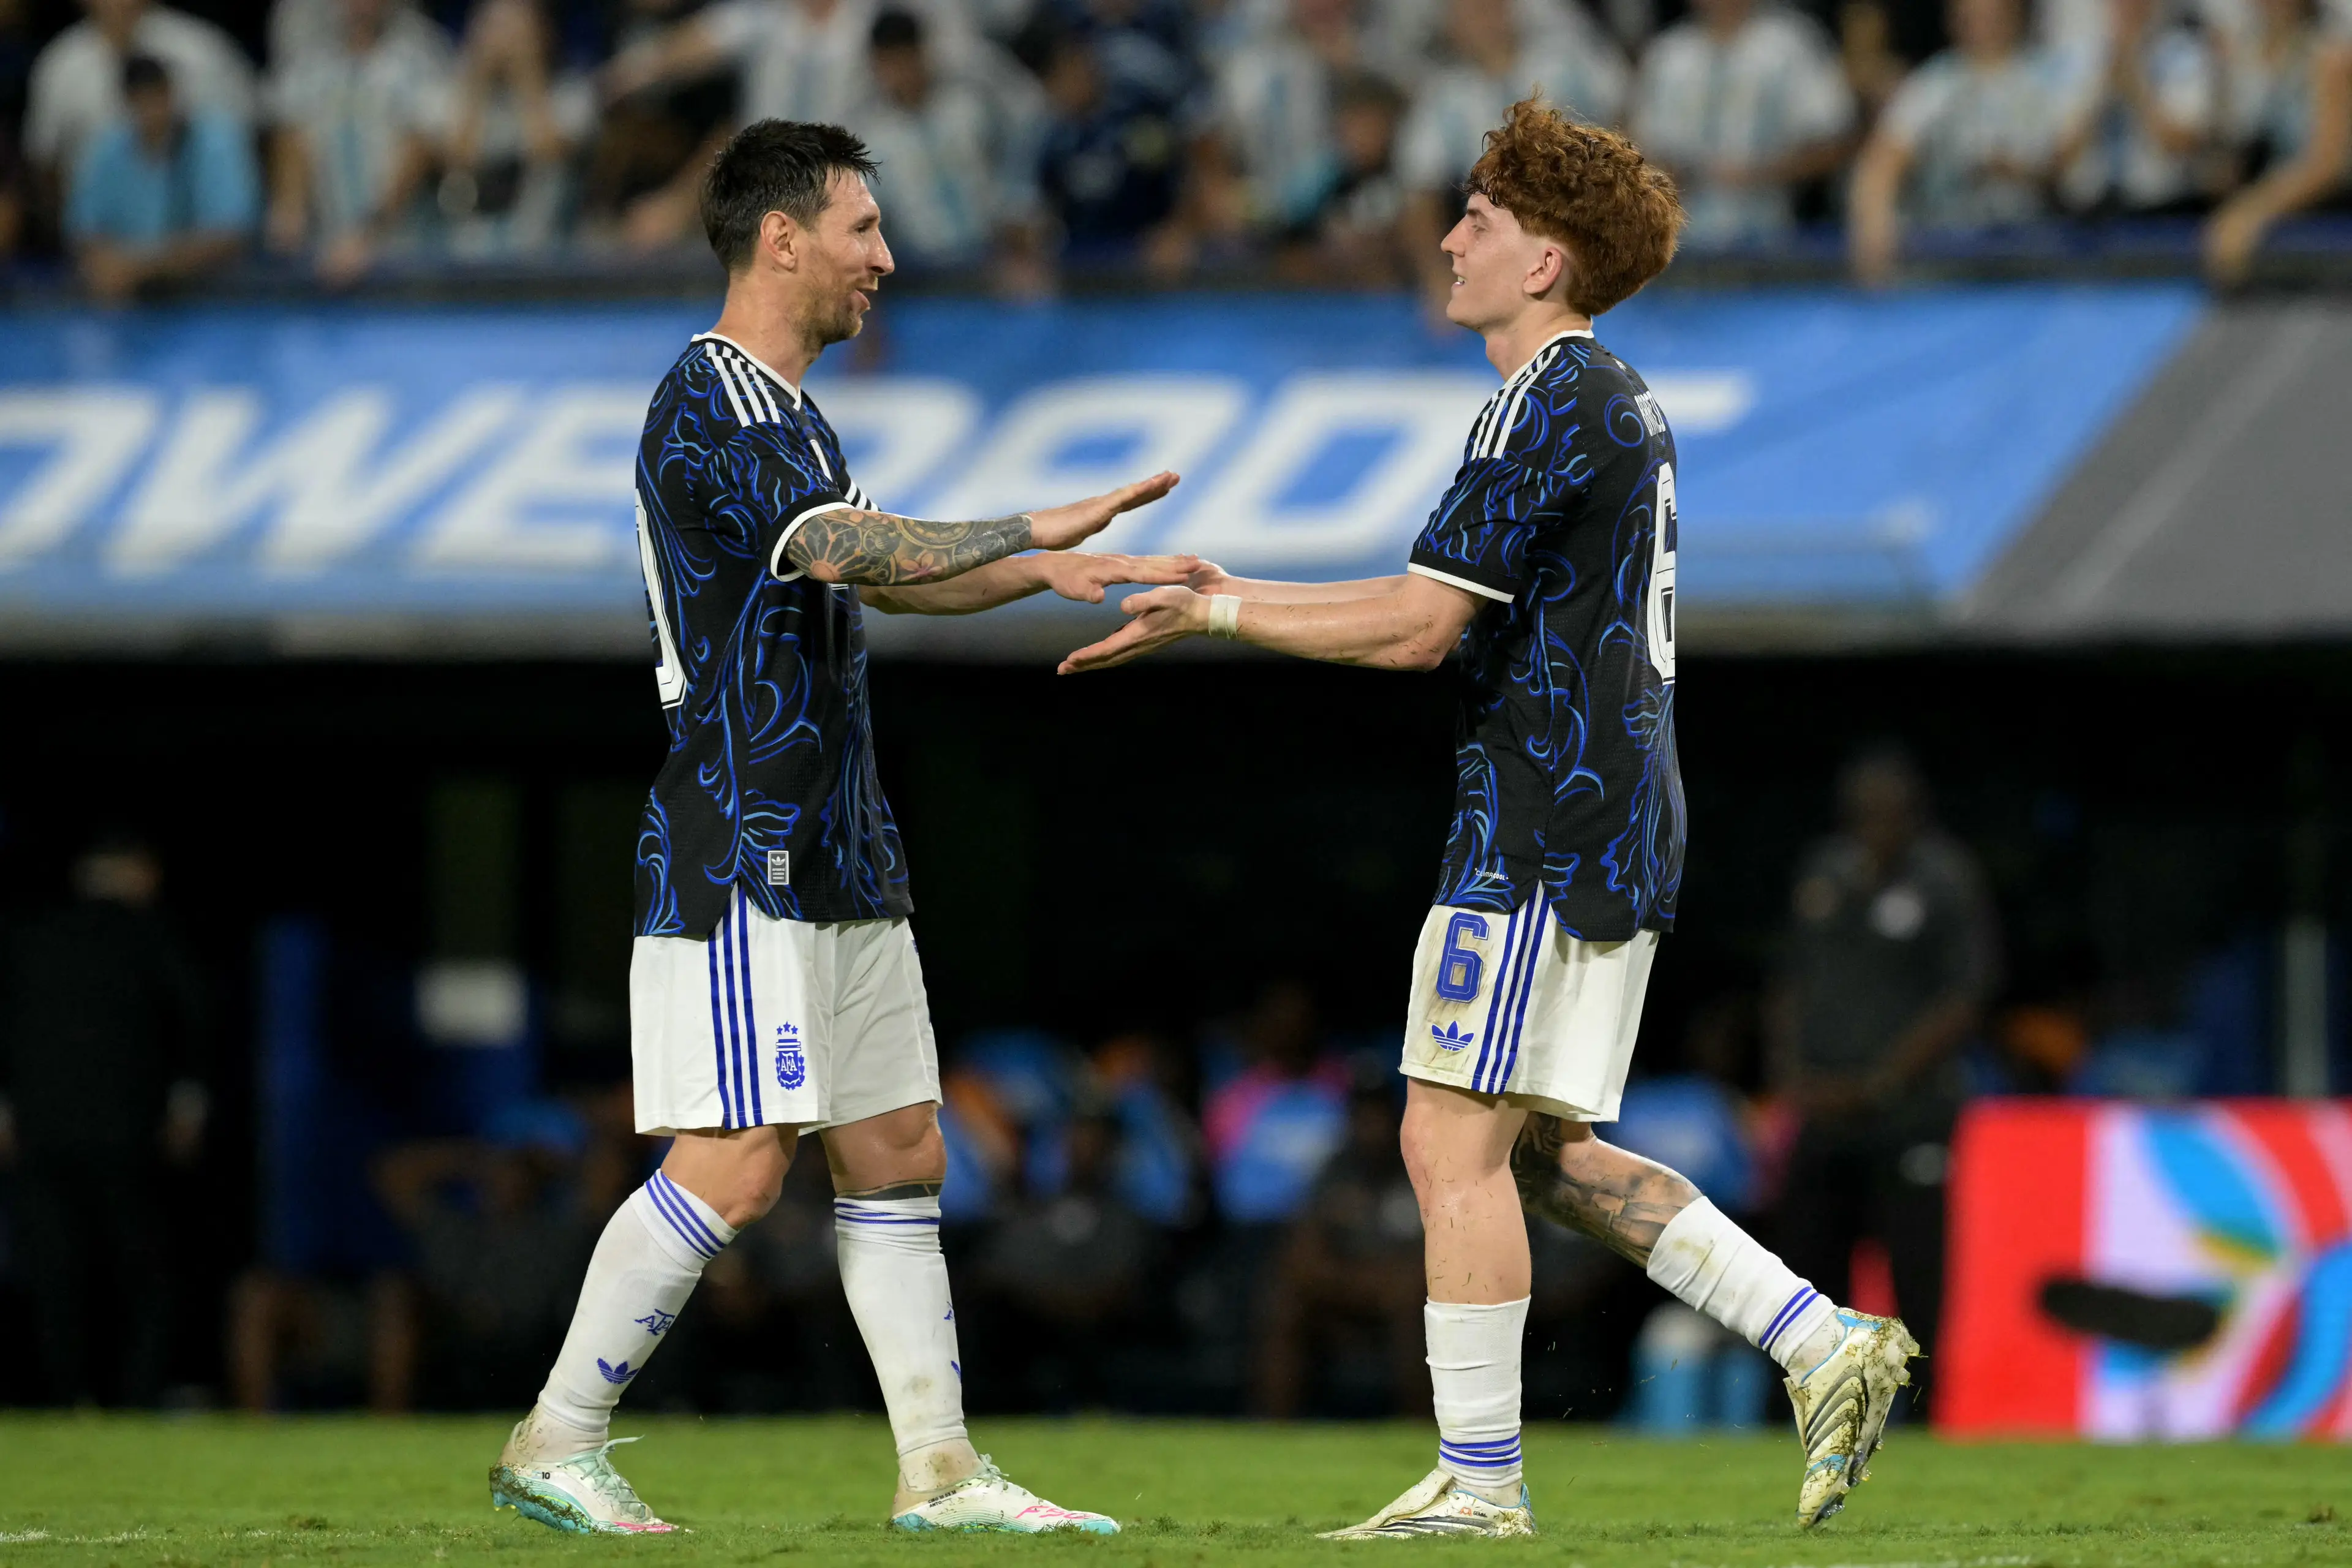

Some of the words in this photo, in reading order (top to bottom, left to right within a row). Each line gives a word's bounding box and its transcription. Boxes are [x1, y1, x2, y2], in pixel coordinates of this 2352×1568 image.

[1476, 870, 1506, 881] CLIMACOOL
[1436, 911, 1490, 1004] 6
[780, 1052, 798, 1076] AFA
[635, 1308, 675, 1336] AFA
[541, 1471, 551, 1480] 10
